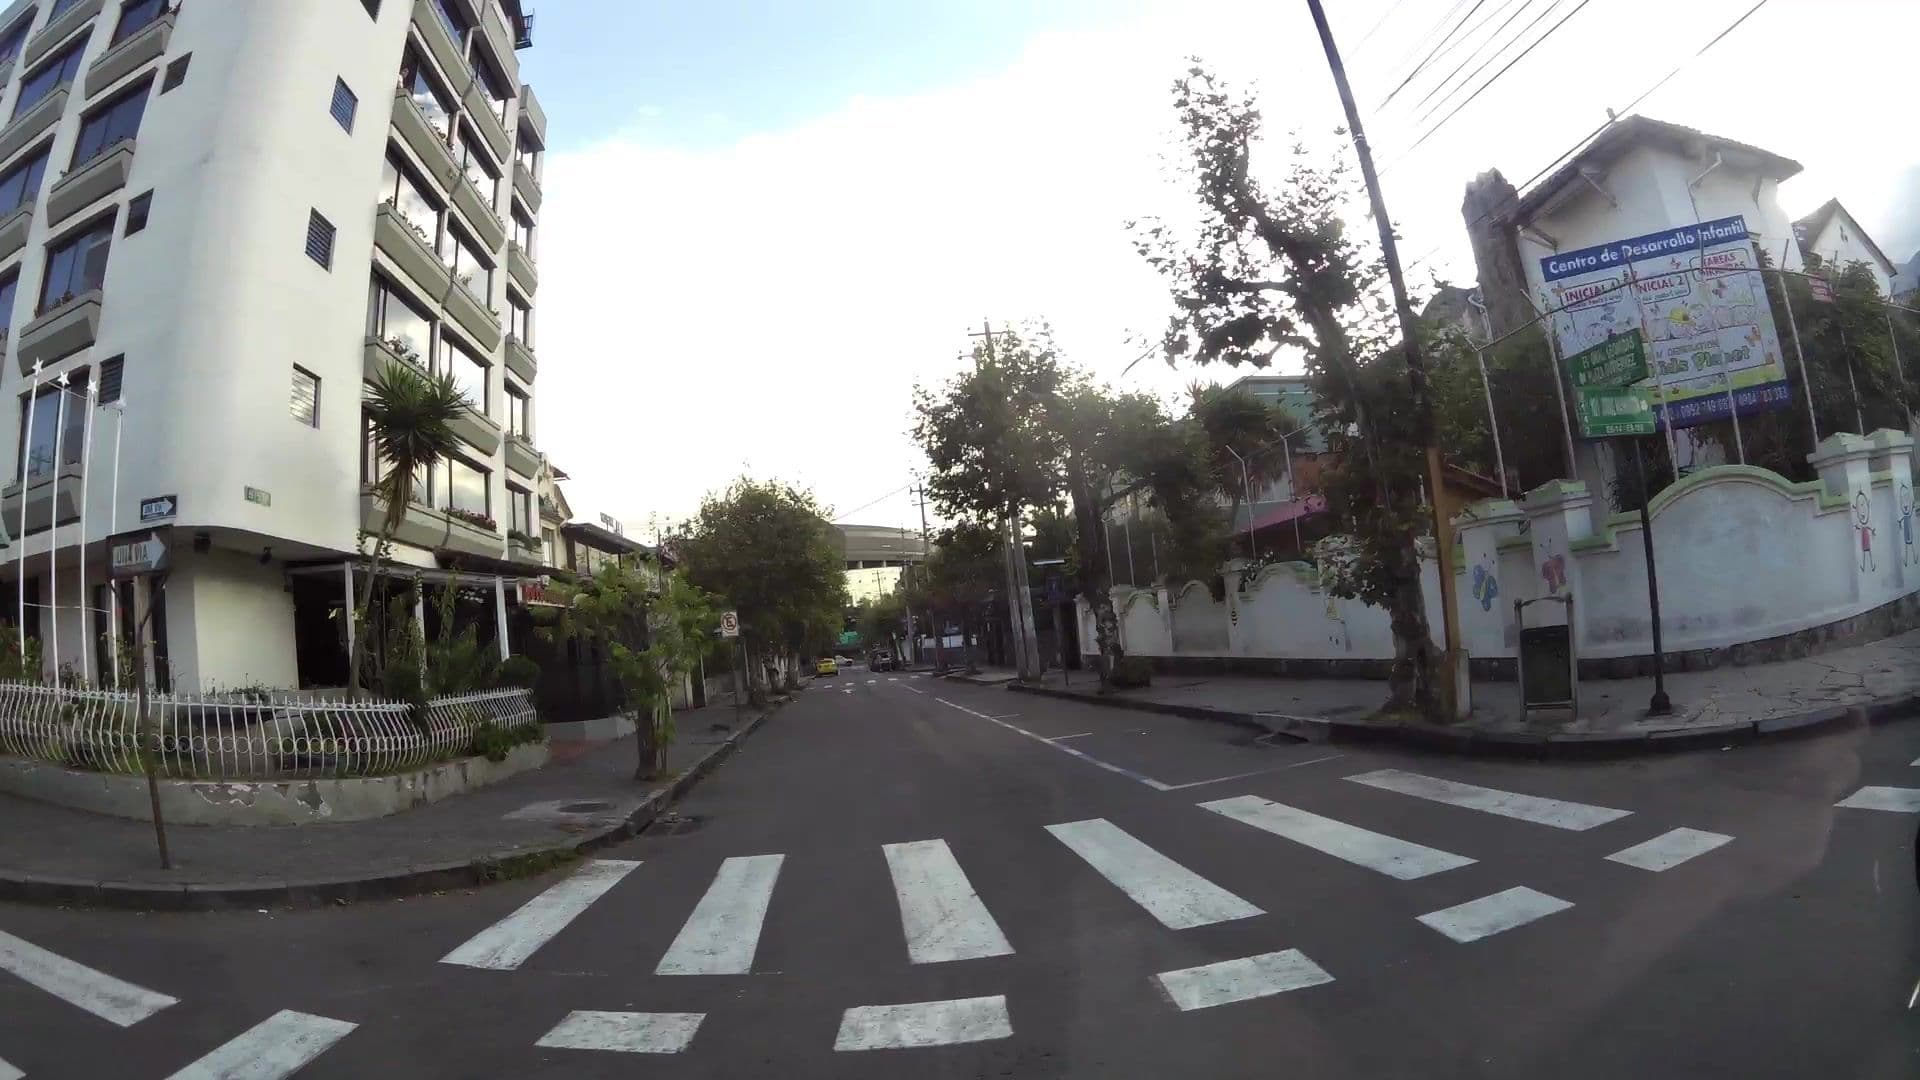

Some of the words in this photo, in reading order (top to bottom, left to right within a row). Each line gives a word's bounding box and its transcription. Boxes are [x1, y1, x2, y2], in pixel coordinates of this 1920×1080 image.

[1550, 254, 1597, 274] Centro
[1600, 247, 1618, 262] de
[1622, 231, 1695, 258] Desarrollo
[1697, 219, 1746, 242] Infantil
[1565, 284, 1610, 302] INICIAL
[1635, 279, 1674, 294] NICIAL
